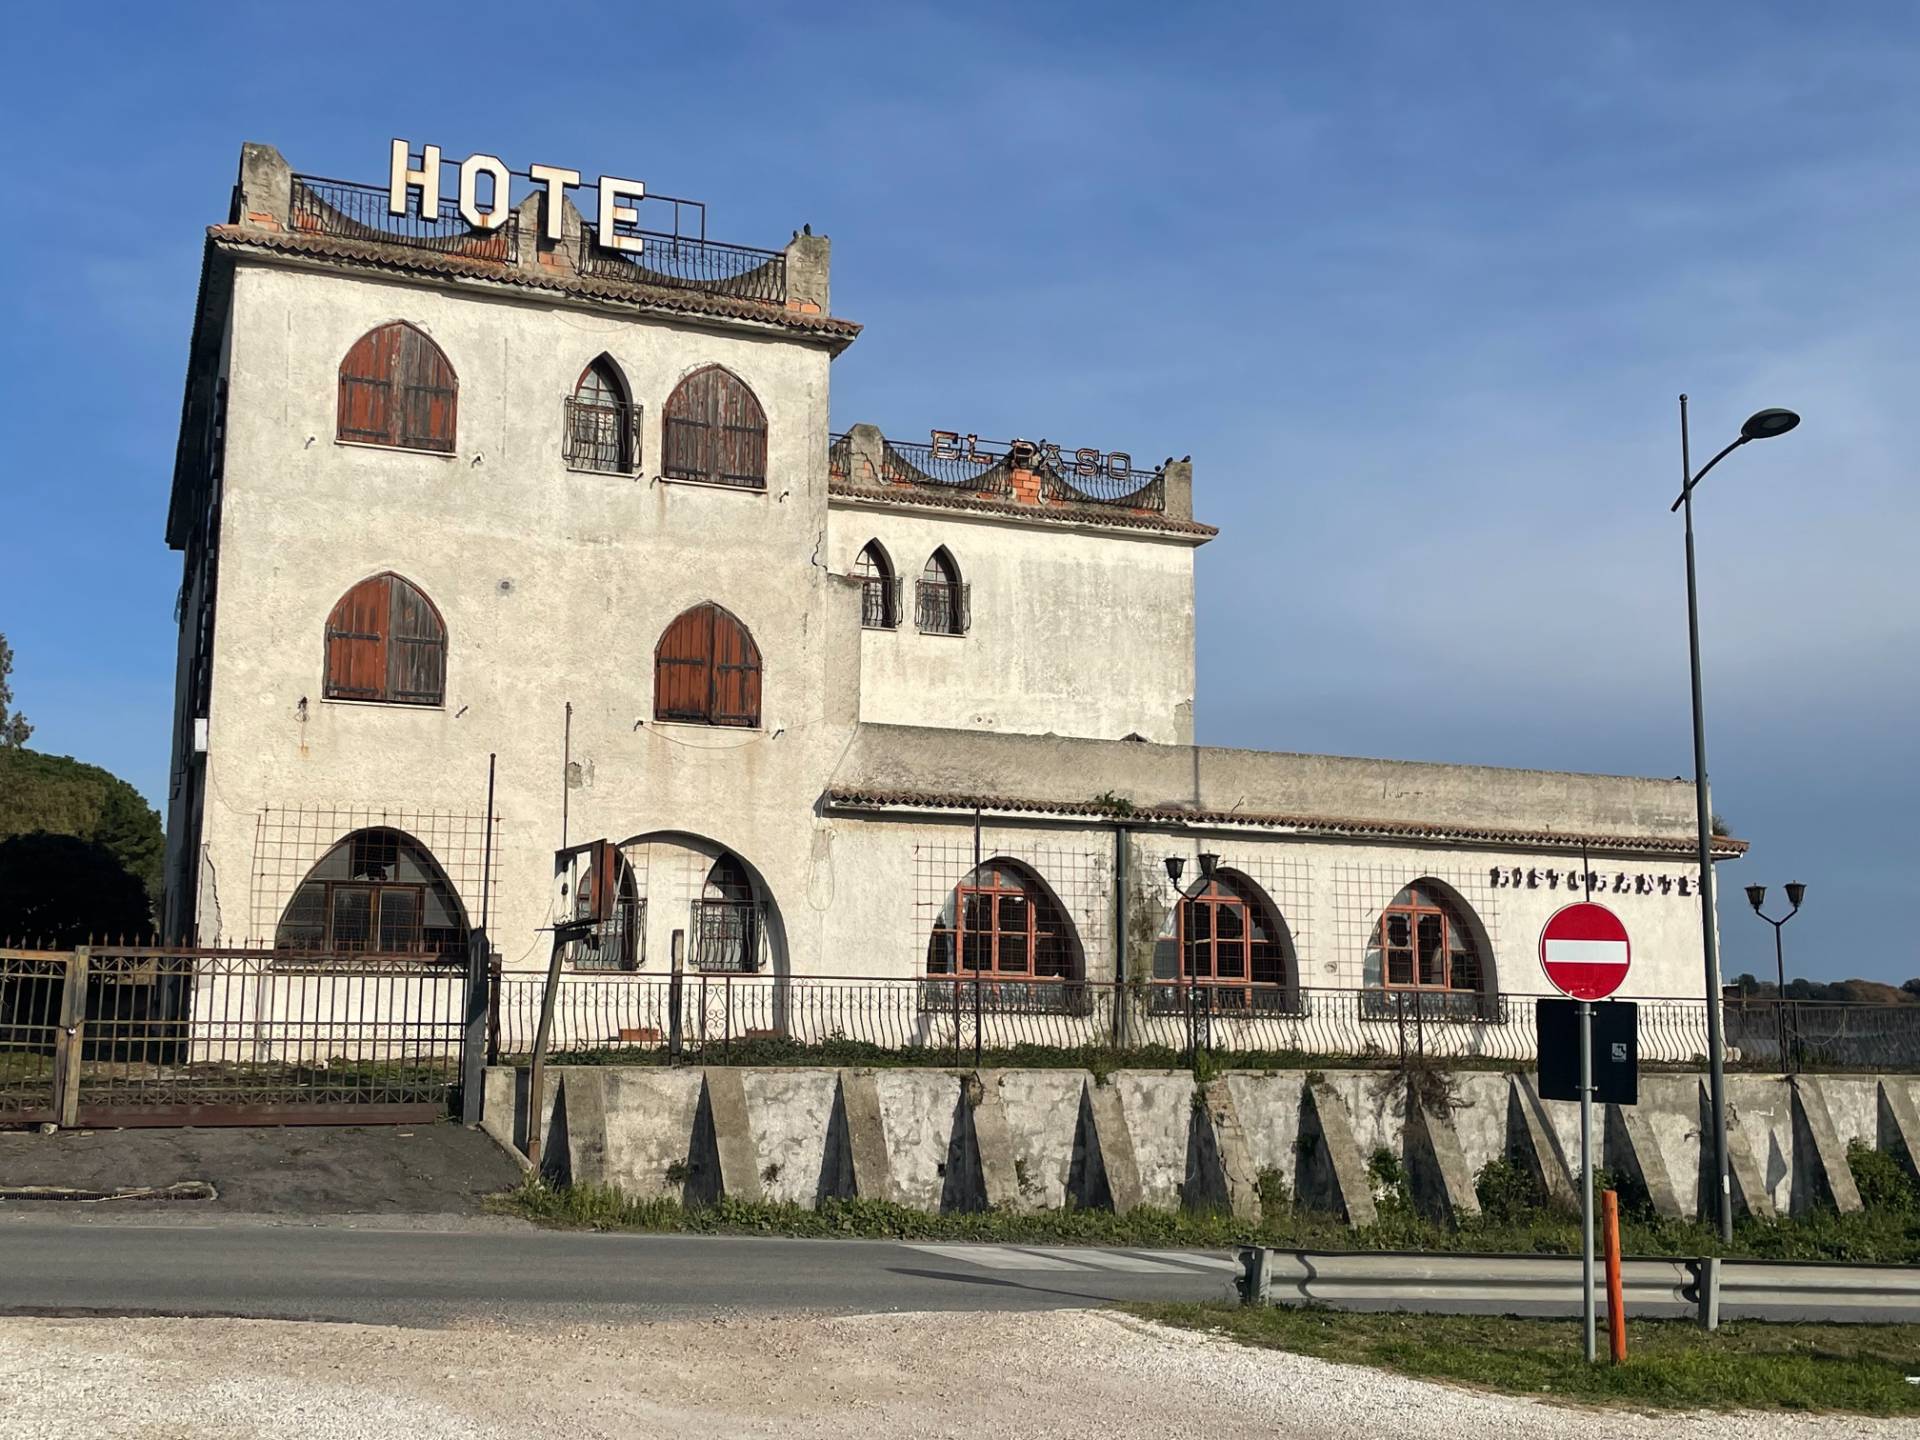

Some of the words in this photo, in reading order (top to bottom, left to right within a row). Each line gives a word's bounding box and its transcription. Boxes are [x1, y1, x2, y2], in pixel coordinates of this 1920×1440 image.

[389, 138, 645, 255] HOTE
[931, 429, 994, 464] EL
[1011, 439, 1132, 480] PASO
[1489, 866, 1700, 896] RISTORANTE
